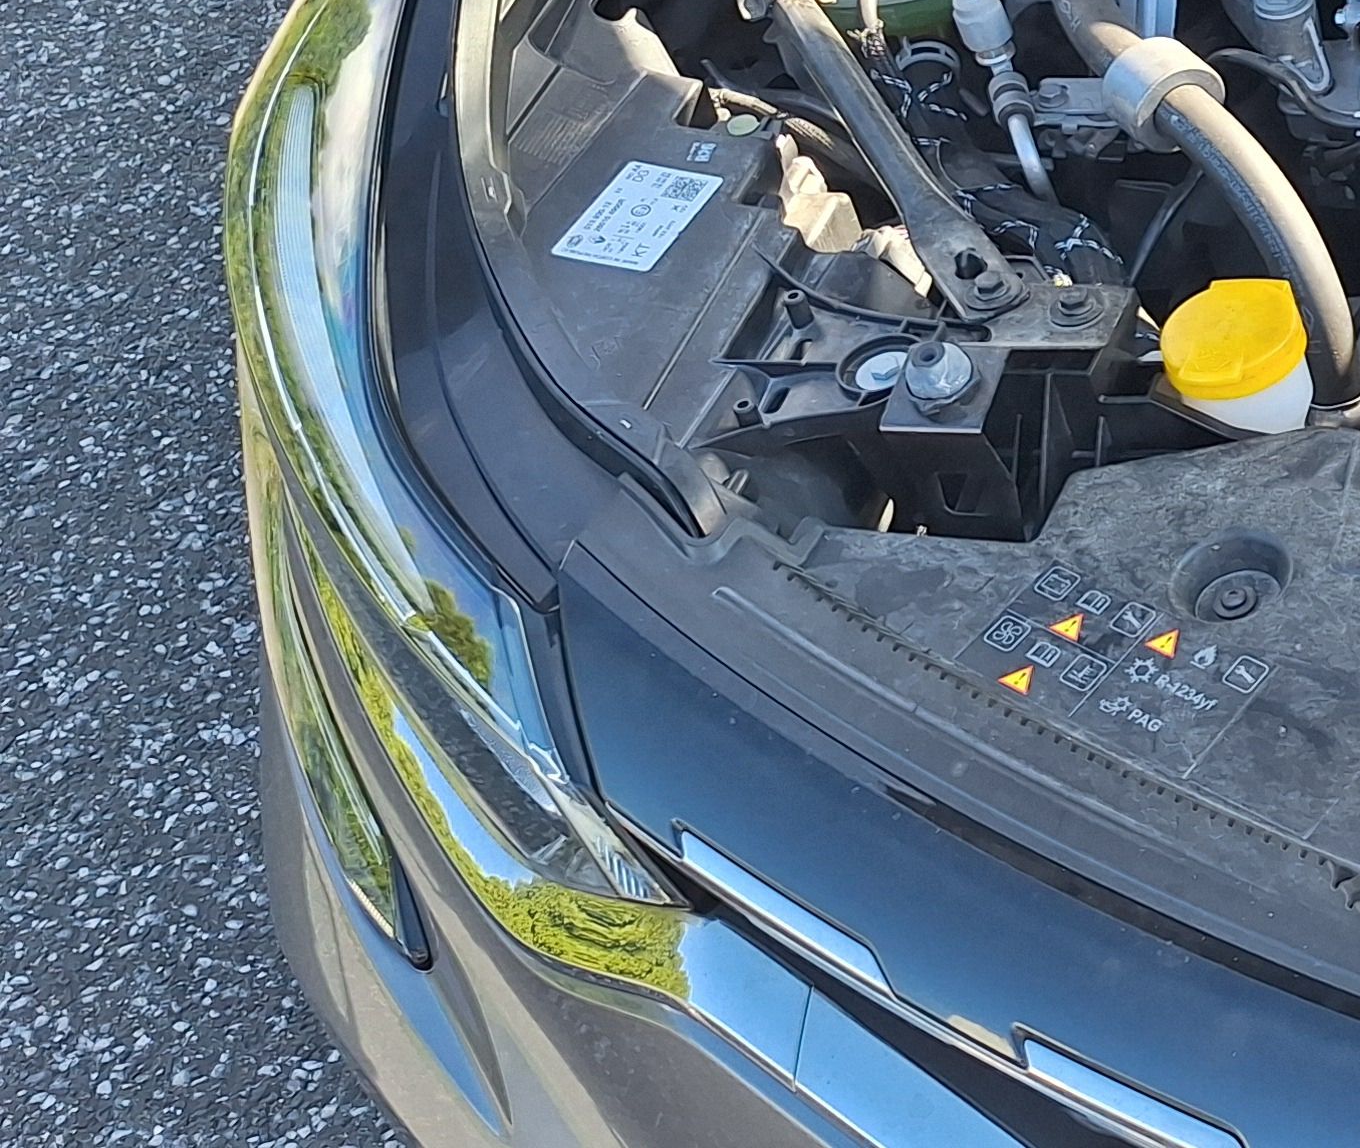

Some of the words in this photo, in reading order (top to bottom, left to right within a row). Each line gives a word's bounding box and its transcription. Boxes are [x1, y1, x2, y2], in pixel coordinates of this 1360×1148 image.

[630, 168, 651, 183] DG
[629, 242, 653, 258] KT
[1154, 674, 1219, 710] R-1234yf
[1127, 708, 1165, 732] PAG
